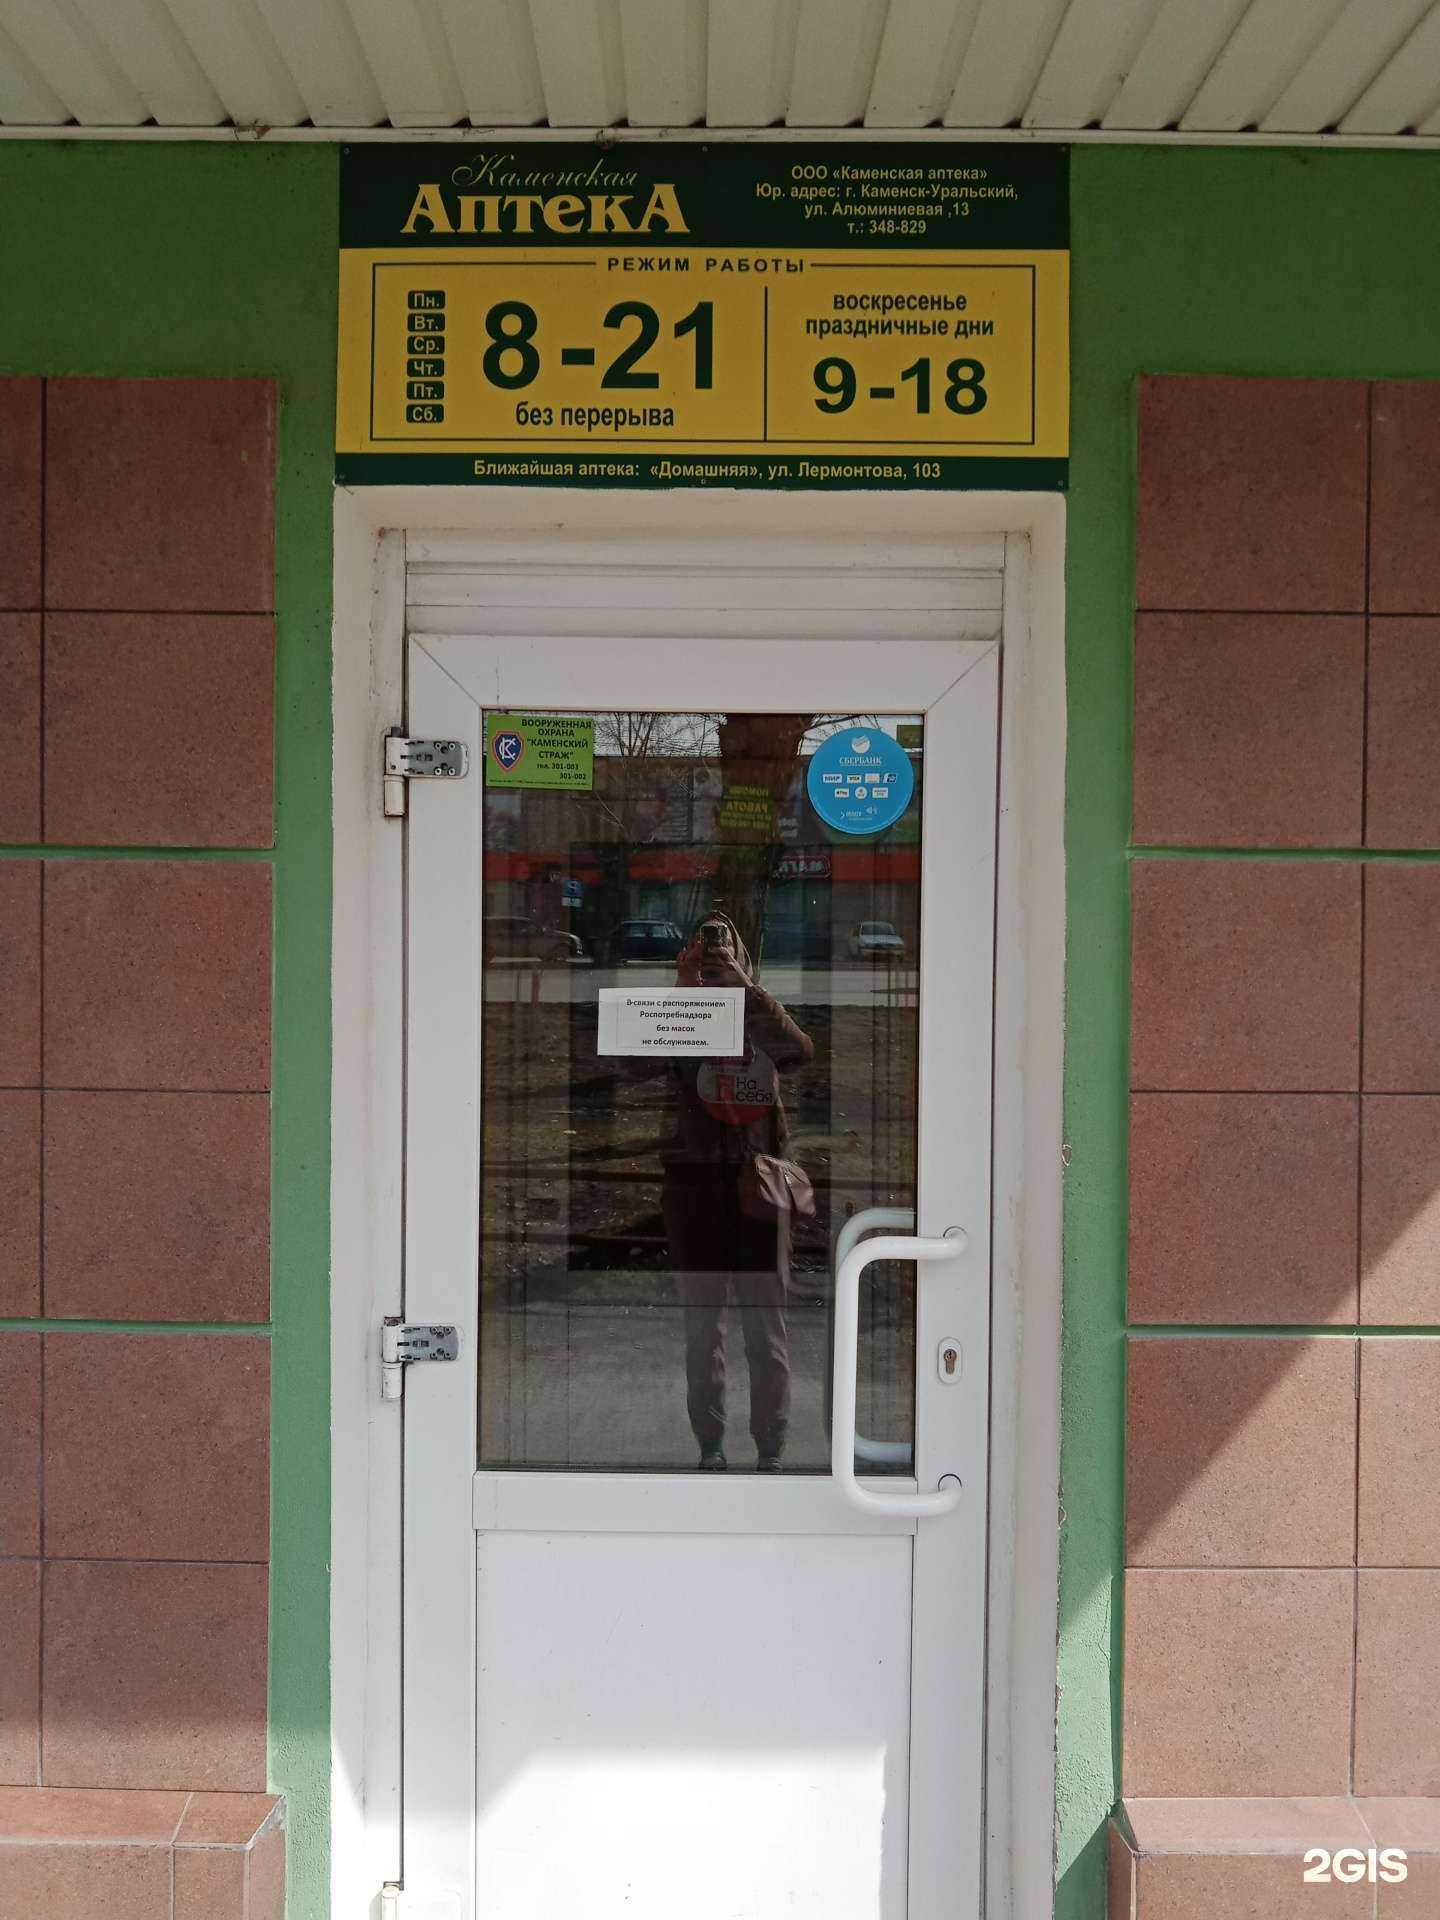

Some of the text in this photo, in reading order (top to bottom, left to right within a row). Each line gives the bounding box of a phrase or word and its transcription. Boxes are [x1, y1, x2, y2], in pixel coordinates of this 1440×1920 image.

[451, 154, 639, 187] Каменская
[791, 165, 987, 181] ООО «Каменская аптека»
[756, 183, 1019, 200] Юр. адрес: г. Каменск-Уральский,
[804, 205, 828, 219] ул.
[832, 202, 943, 217] Алюминиевая
[848, 220, 927, 235] т.: 348-829
[607, 257, 804, 273] РЕЖИМ РАБОТЫ
[413, 293, 440, 308] Пн.
[833, 294, 967, 314] воскресенье
[414, 316, 439, 331] Вт.
[806, 318, 994, 338] праздничные дни
[413, 337, 440, 354] Ср.
[413, 361, 439, 376] Чт.
[413, 383, 439, 398] Пт.
[813, 356, 988, 416] 9-18
[412, 406, 437, 421] Сб.
[515, 401, 674, 432] без перерыва
[474, 460, 941, 480] Ближайшая аптека: «Домашняя», ул. Лермонтова, 103
[521, 719, 592, 730] ВООРУЖЕННАЯ
[538, 729, 575, 738] ОХРАНА
[527, 739, 588, 749] "КАМЕНСКИЙ
[538, 752, 574, 761] СТРАЖ"
[839, 756, 882, 765] СБЕРБАНК
[662, 1001, 726, 1009] распоряжением
[640, 1010, 712, 1020] Роспотребнадзора
[656, 1024, 670, 1032] без
[642, 1038, 652, 1046] не
[736, 1075, 757, 1090] На
[736, 1089, 773, 1104] себя
